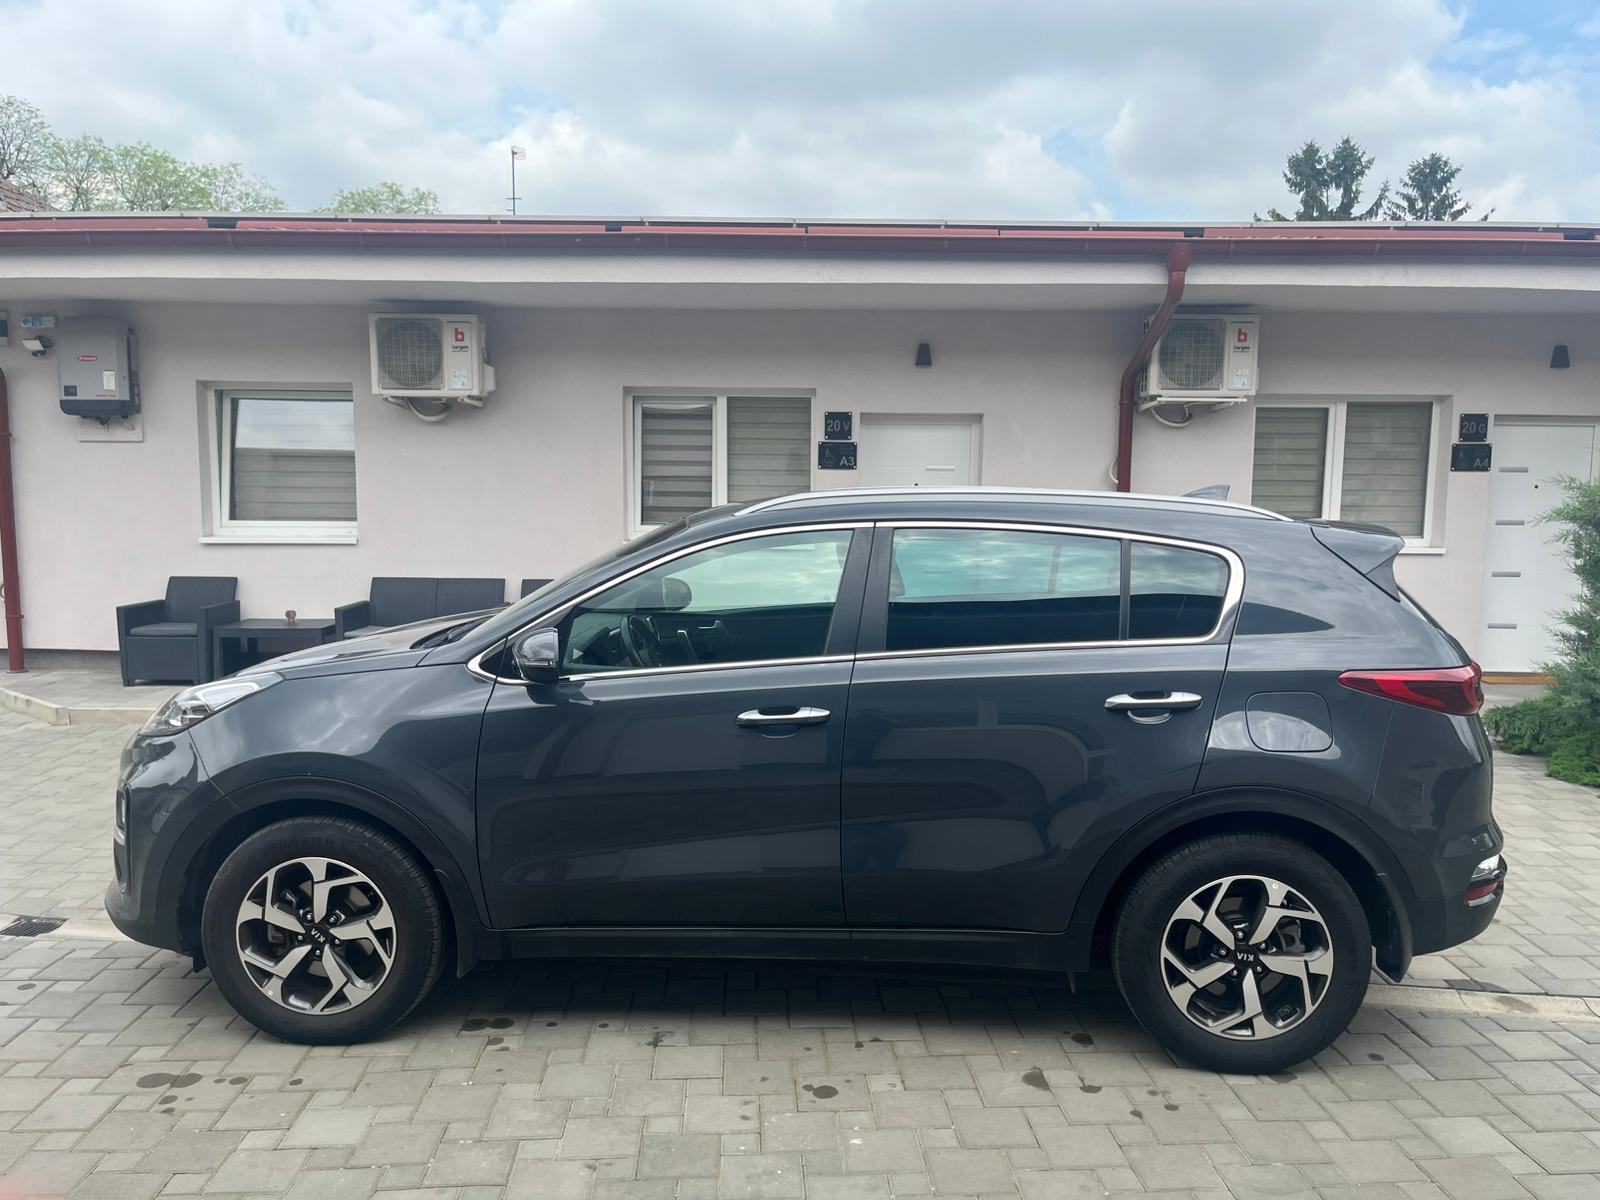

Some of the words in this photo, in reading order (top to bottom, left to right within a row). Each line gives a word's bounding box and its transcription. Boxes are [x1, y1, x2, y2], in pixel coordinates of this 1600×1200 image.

[827, 419, 840, 432] 20
[1462, 421, 1477, 433] 20
[839, 455, 855, 467] A3
[1472, 458, 1489, 468] A4
[311, 927, 326, 943] KIA
[1236, 952, 1255, 962] KIA
